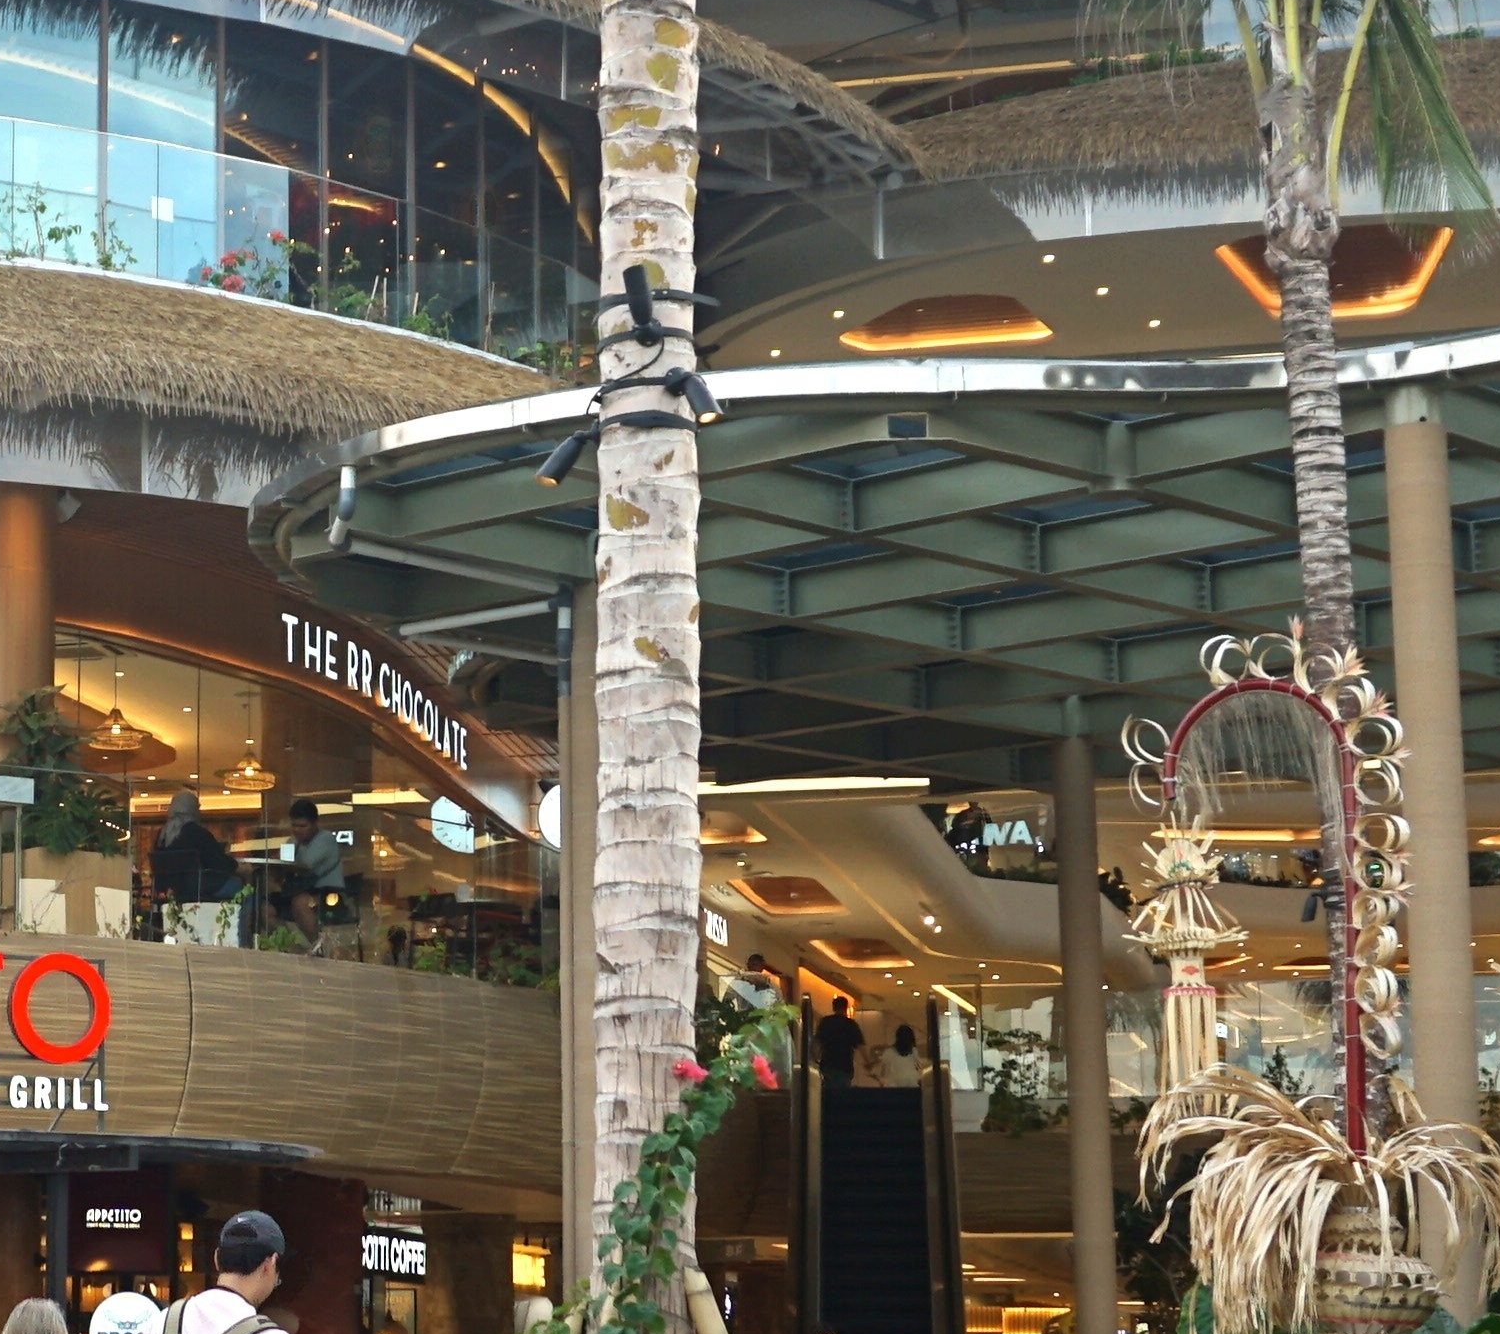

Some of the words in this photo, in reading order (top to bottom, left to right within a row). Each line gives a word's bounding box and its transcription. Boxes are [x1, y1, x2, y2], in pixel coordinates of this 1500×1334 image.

[281, 612, 339, 681] THE
[347, 640, 373, 698] RR
[378, 663, 468, 771] CHOCOLATE
[8, 1075, 110, 1111] GRILL
[86, 1208, 142, 1223] APPETITO
[390, 1237, 427, 1276] COFFE
